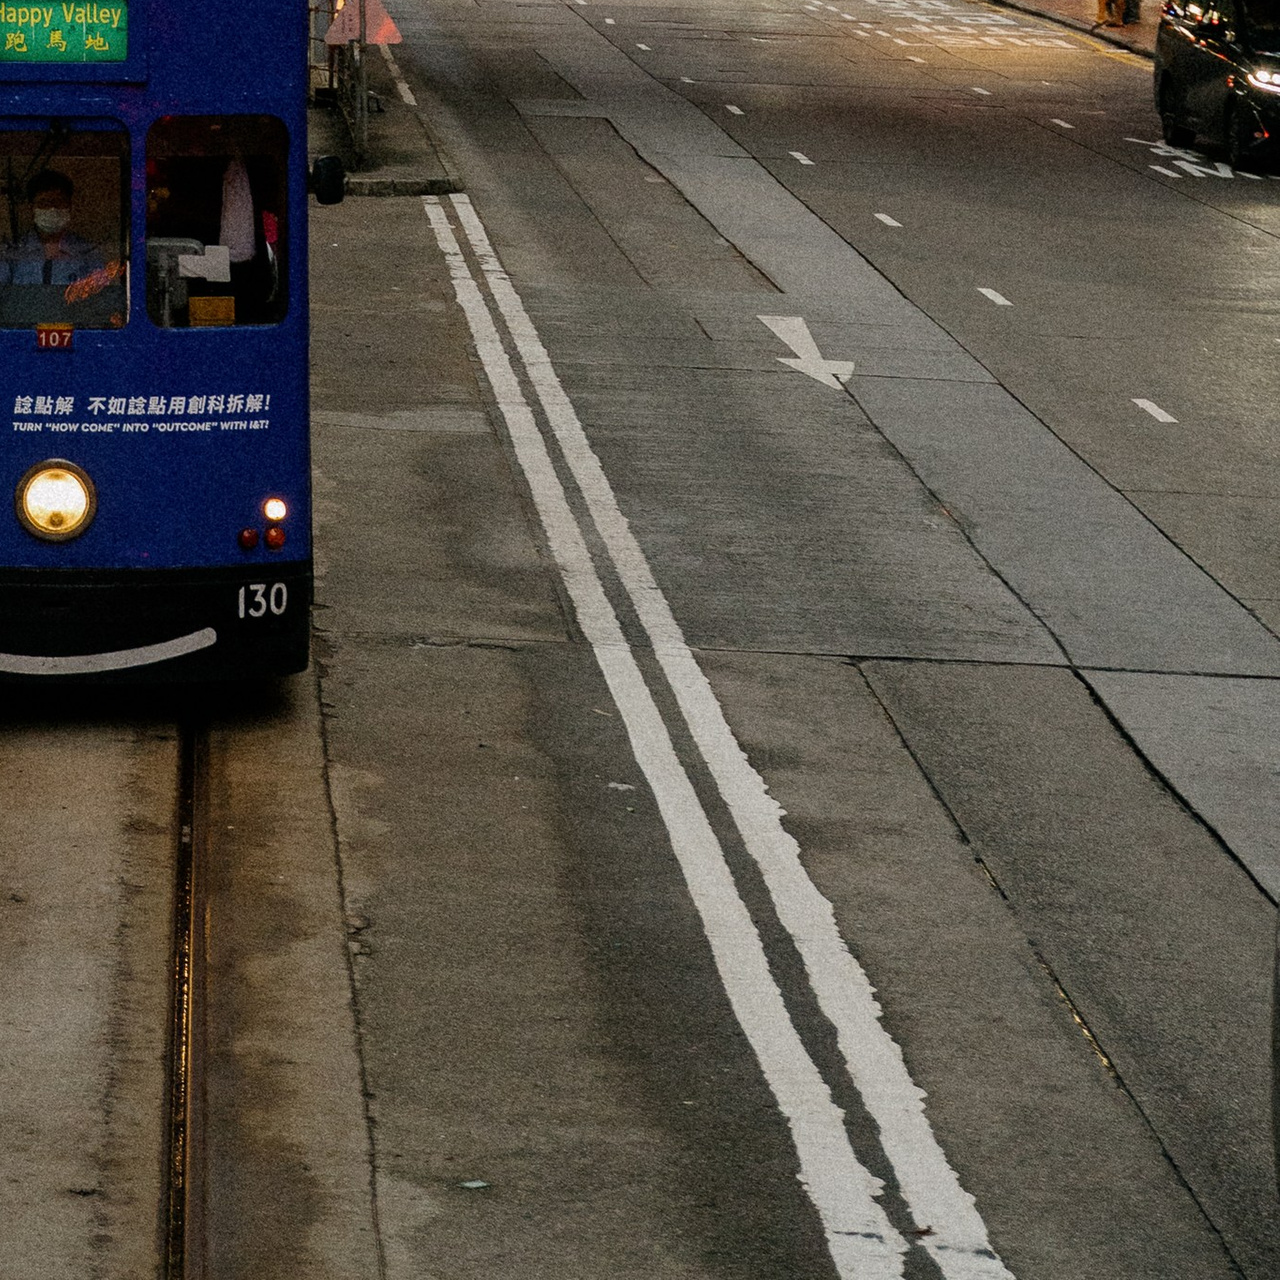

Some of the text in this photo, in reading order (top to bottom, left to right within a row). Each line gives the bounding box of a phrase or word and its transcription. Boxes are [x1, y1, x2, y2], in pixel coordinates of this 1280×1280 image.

[63, 2, 122, 28] Valley
[4, 29, 109, 52] 跑馬地
[39, 332, 72, 346] 107
[13, 396, 75, 415] 諗點解
[12, 422, 43, 432] TURN
[122, 422, 150, 432] INTO
[220, 420, 248, 430] WITH
[238, 583, 288, 619] 130
